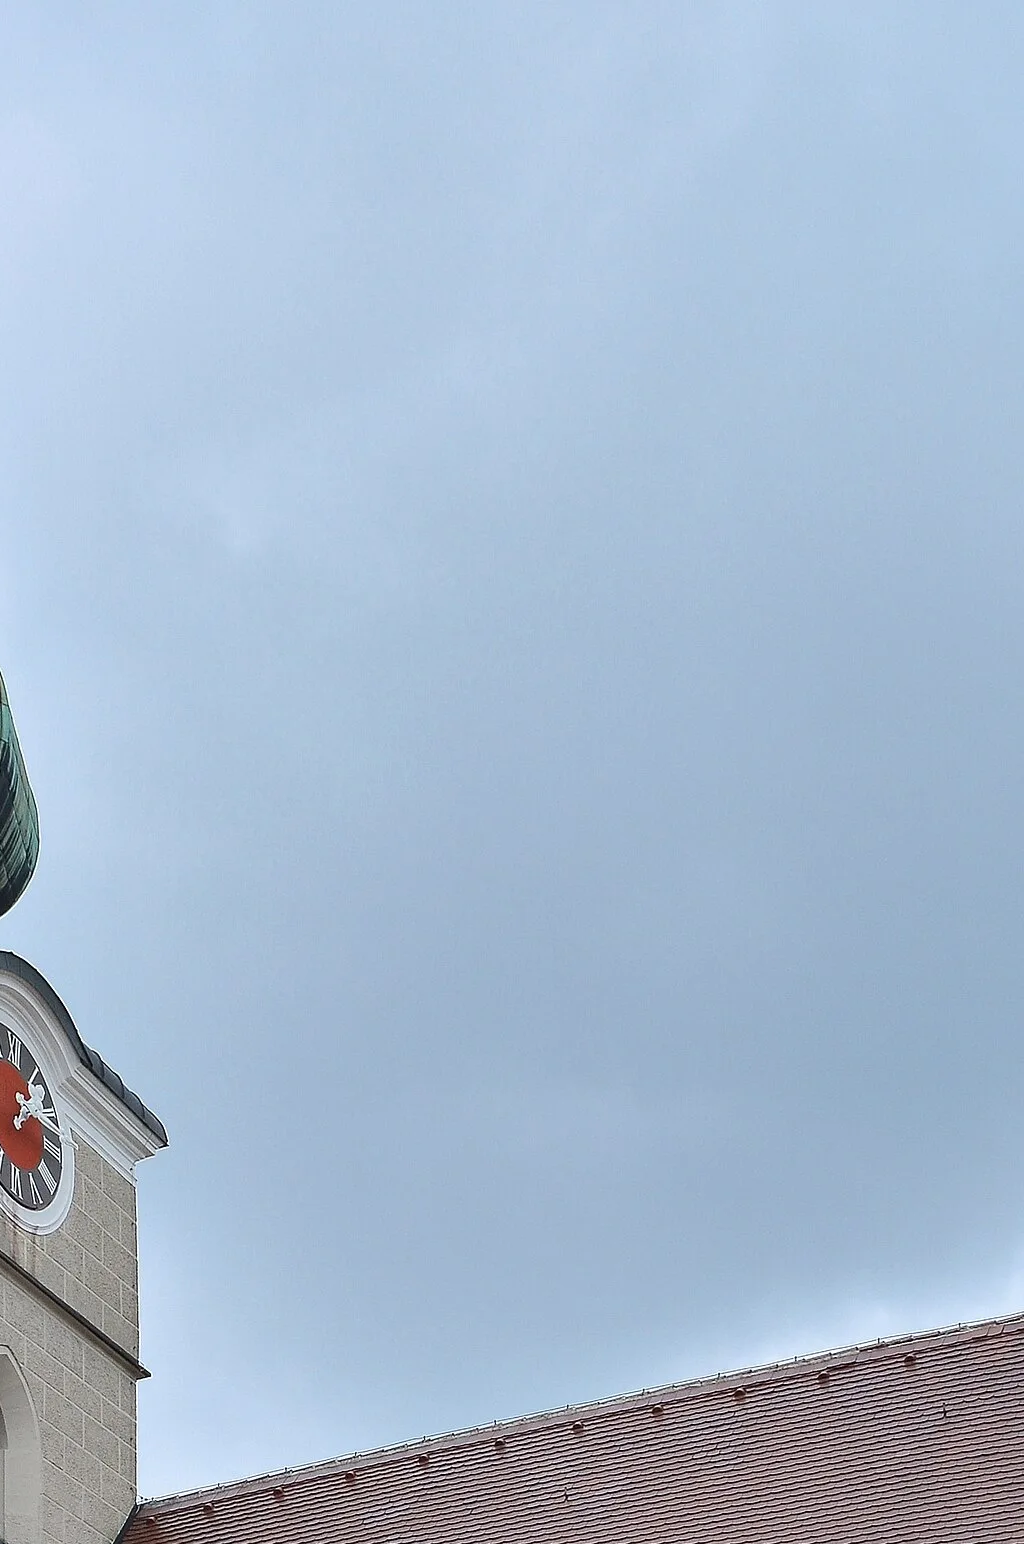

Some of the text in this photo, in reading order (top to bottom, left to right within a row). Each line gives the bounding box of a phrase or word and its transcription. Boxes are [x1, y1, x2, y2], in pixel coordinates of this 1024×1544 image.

[7, 1030, 22, 1071] XII
[43, 1135, 61, 1163] III
[10, 1163, 23, 1200] VI
[28, 1172, 44, 1205] V
[38, 1158, 57, 1196] IIII
